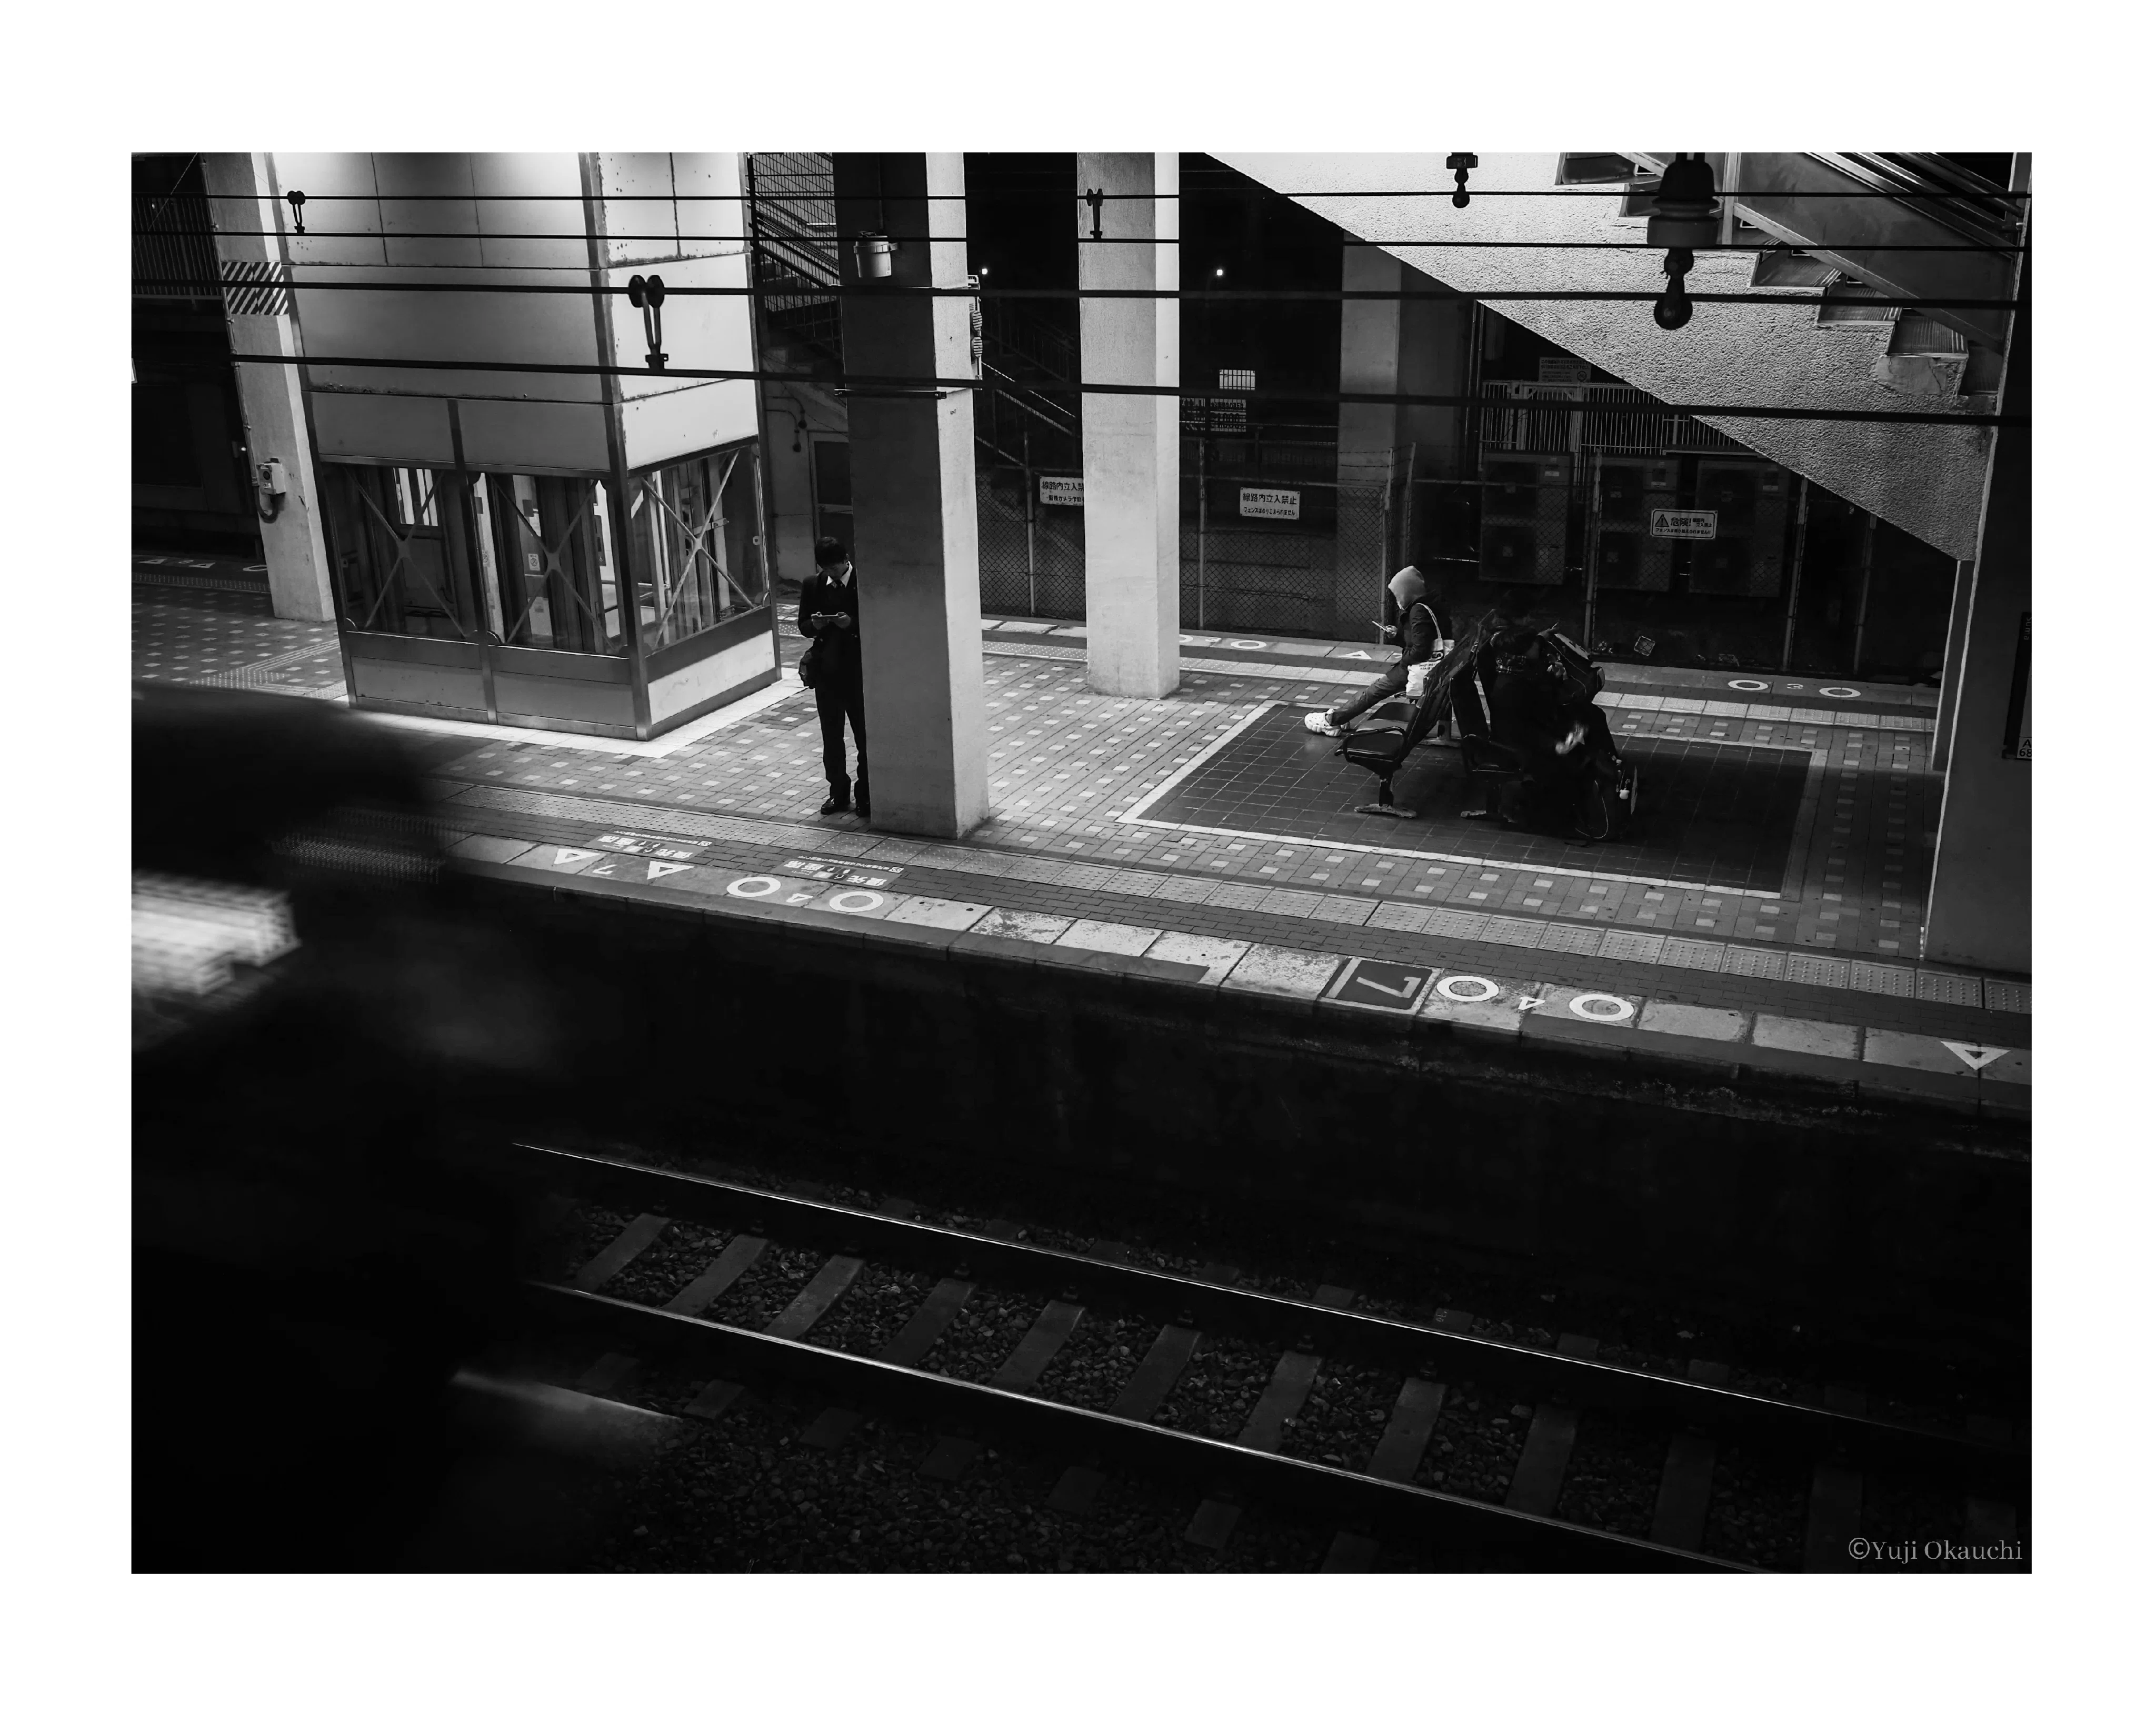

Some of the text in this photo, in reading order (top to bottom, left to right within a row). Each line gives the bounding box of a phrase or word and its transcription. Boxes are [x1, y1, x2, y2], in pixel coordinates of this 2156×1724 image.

[1042, 481, 1083, 491] 線路内立入禁
[1243, 493, 1296, 505] 線路内立入禁止
[1244, 507, 1295, 516] フェンスはのりこえられません
[2023, 739, 2031, 748] A
[2020, 748, 2031, 757] 68
[592, 864, 617, 874] 7
[1518, 996, 1546, 1010] 4
